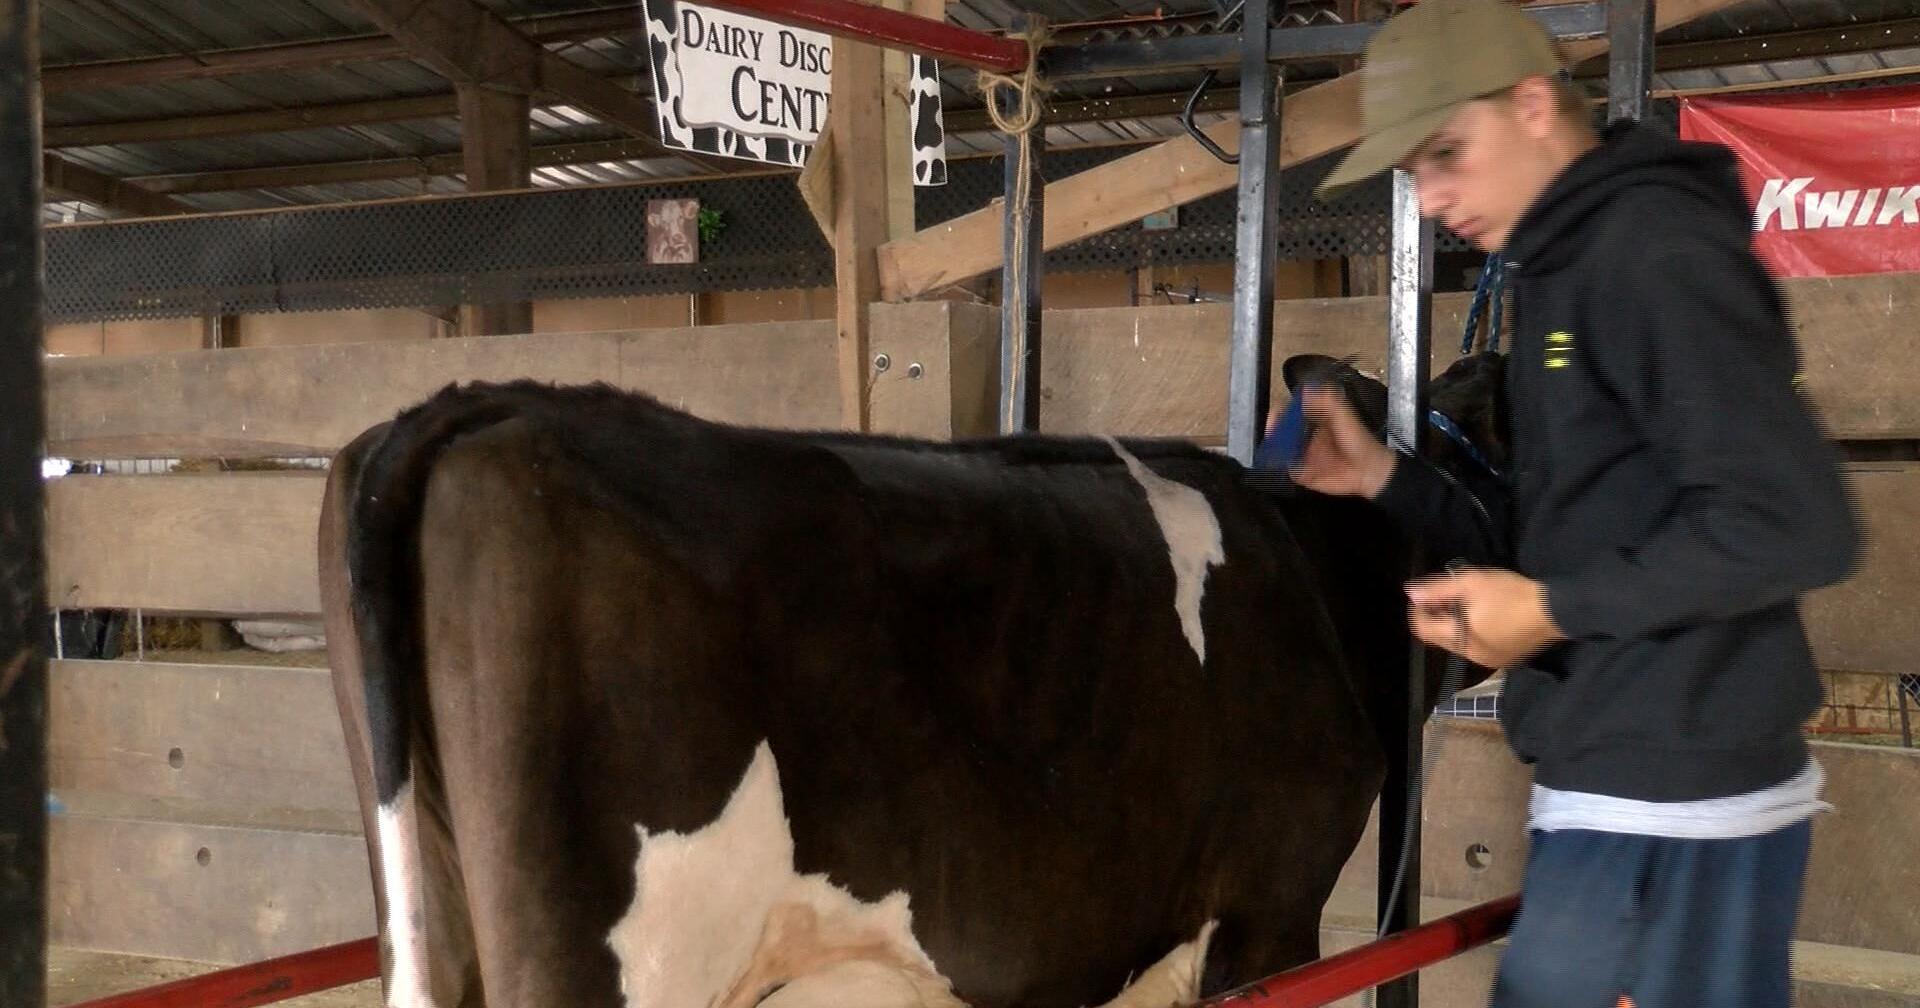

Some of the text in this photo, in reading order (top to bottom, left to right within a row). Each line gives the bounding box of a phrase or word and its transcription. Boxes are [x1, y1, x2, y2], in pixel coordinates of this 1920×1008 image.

[681, 9, 764, 62] DAIRY
[731, 65, 832, 134] CENT
[1752, 176, 1920, 231] KWIK
